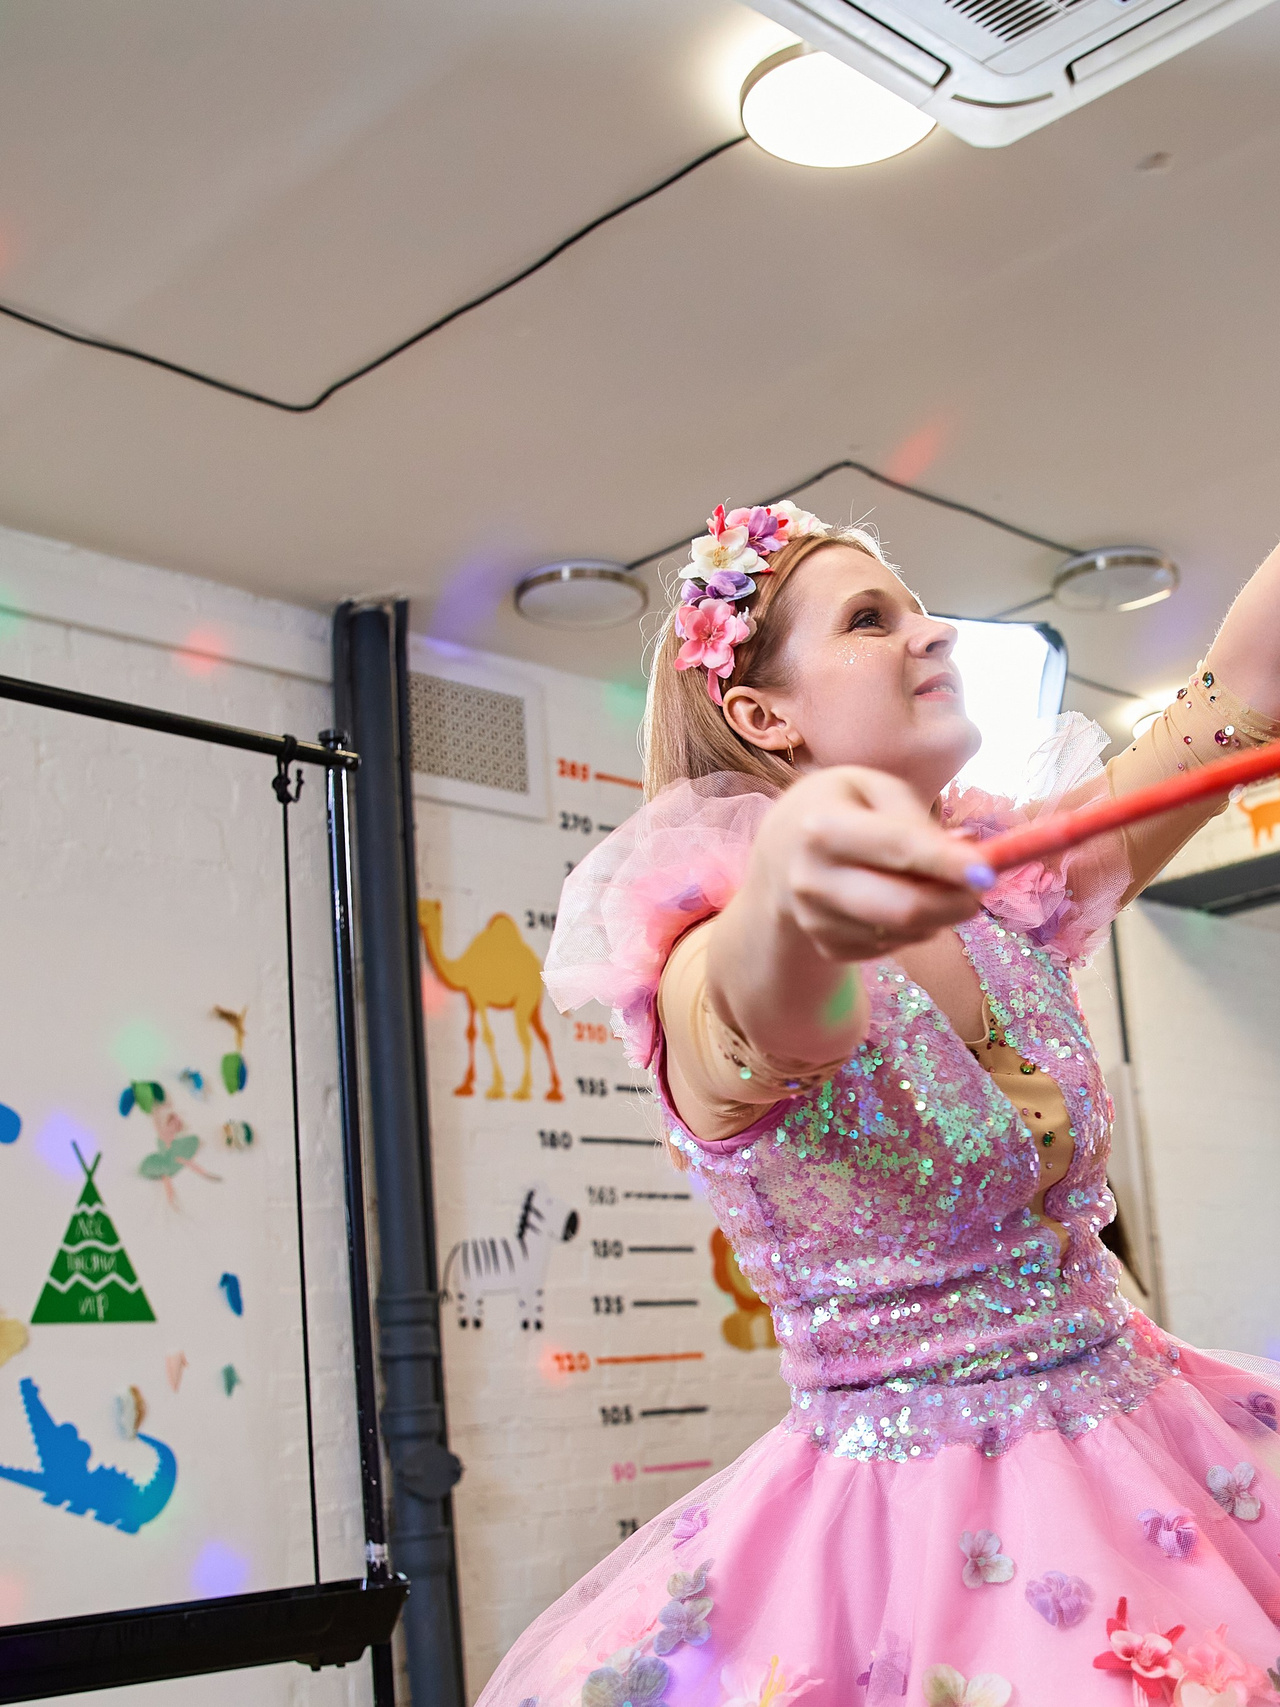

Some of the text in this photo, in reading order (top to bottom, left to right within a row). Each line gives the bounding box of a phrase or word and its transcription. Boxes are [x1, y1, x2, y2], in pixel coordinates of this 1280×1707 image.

[560, 811, 592, 834] 270
[574, 1022, 607, 1044] 210
[575, 1077, 608, 1097] 195
[538, 1130, 572, 1150] 180
[588, 1185, 617, 1205] 165
[591, 1239, 623, 1260] 150
[592, 1295, 624, 1315] 135
[552, 1351, 590, 1373] 120
[599, 1405, 633, 1426] 105
[611, 1462, 637, 1483] 90
